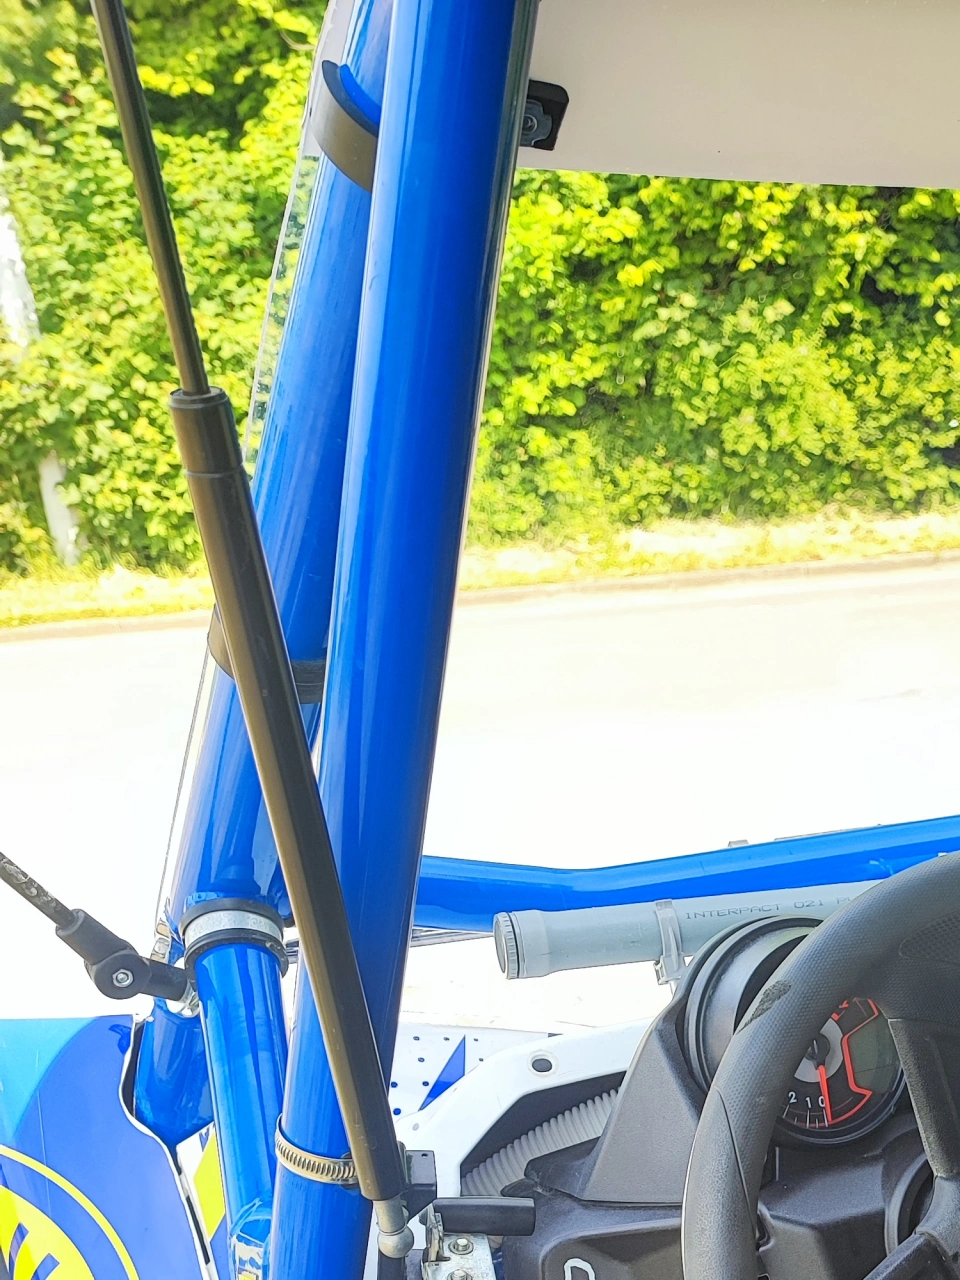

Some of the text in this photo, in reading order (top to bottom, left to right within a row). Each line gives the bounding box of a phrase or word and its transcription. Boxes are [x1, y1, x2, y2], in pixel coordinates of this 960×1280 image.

[685, 903, 782, 920] INTERPACT
[788, 1091, 797, 1103] 2
[805, 1097, 811, 1108] 1
